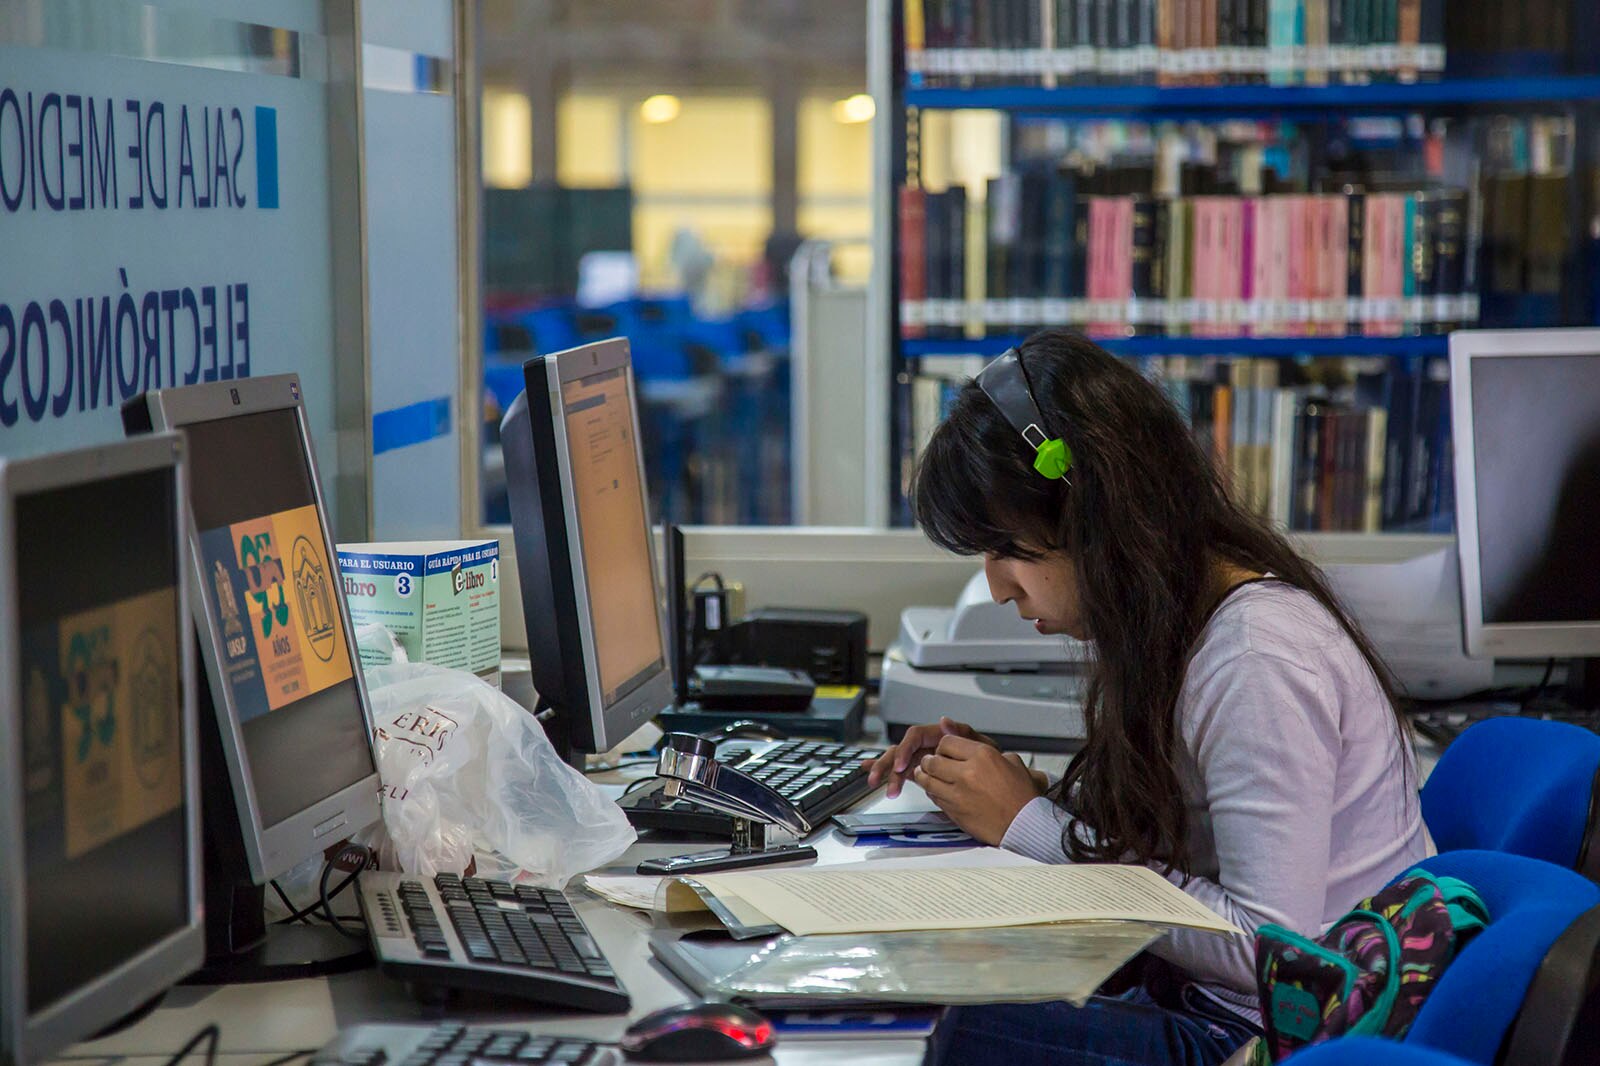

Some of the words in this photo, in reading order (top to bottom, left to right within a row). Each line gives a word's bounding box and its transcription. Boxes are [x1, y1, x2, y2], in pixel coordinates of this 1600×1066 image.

[360, 560, 371, 569] EL
[373, 560, 414, 571] USUARIO
[428, 556, 441, 569] GUÍA
[462, 552, 474, 563] PARA
[398, 576, 411, 595] 3
